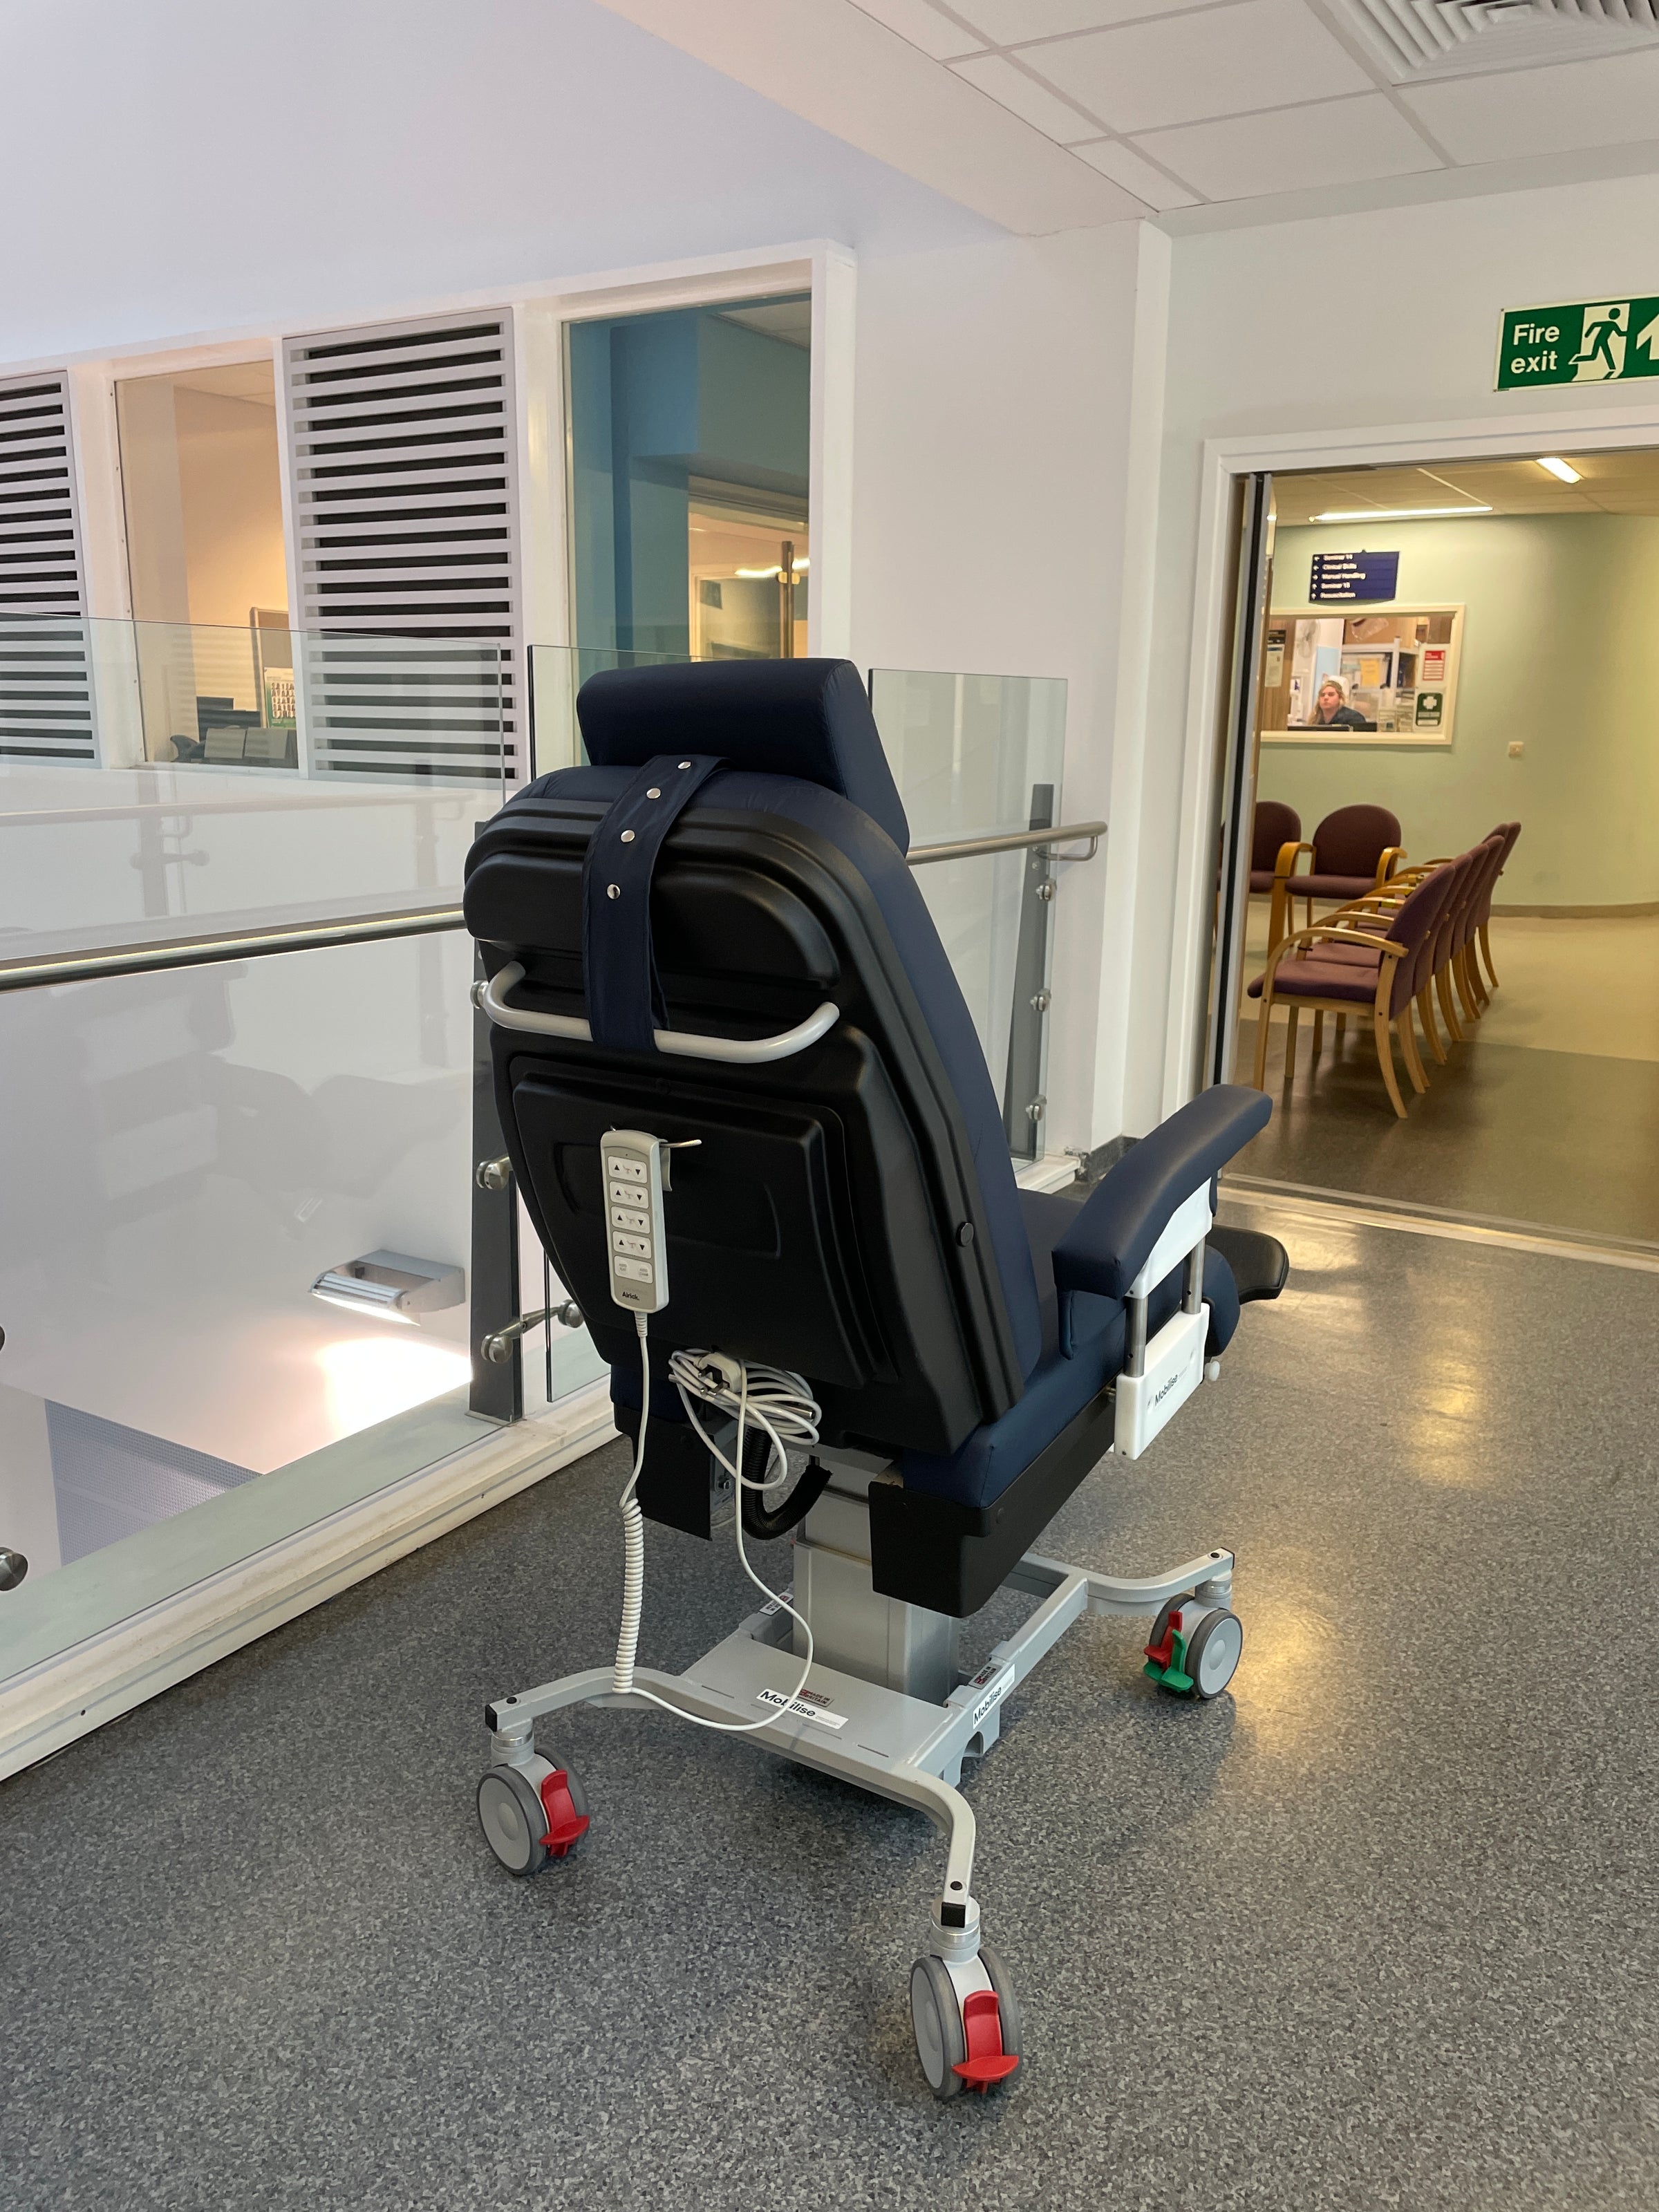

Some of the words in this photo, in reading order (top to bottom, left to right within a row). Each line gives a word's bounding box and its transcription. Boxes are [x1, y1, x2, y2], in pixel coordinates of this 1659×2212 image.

[1513, 324, 1559, 346] Fire
[1511, 350, 1558, 374] exit
[1155, 1374, 1178, 1406] Mobilise
[974, 1687, 1002, 1724] Mobilise
